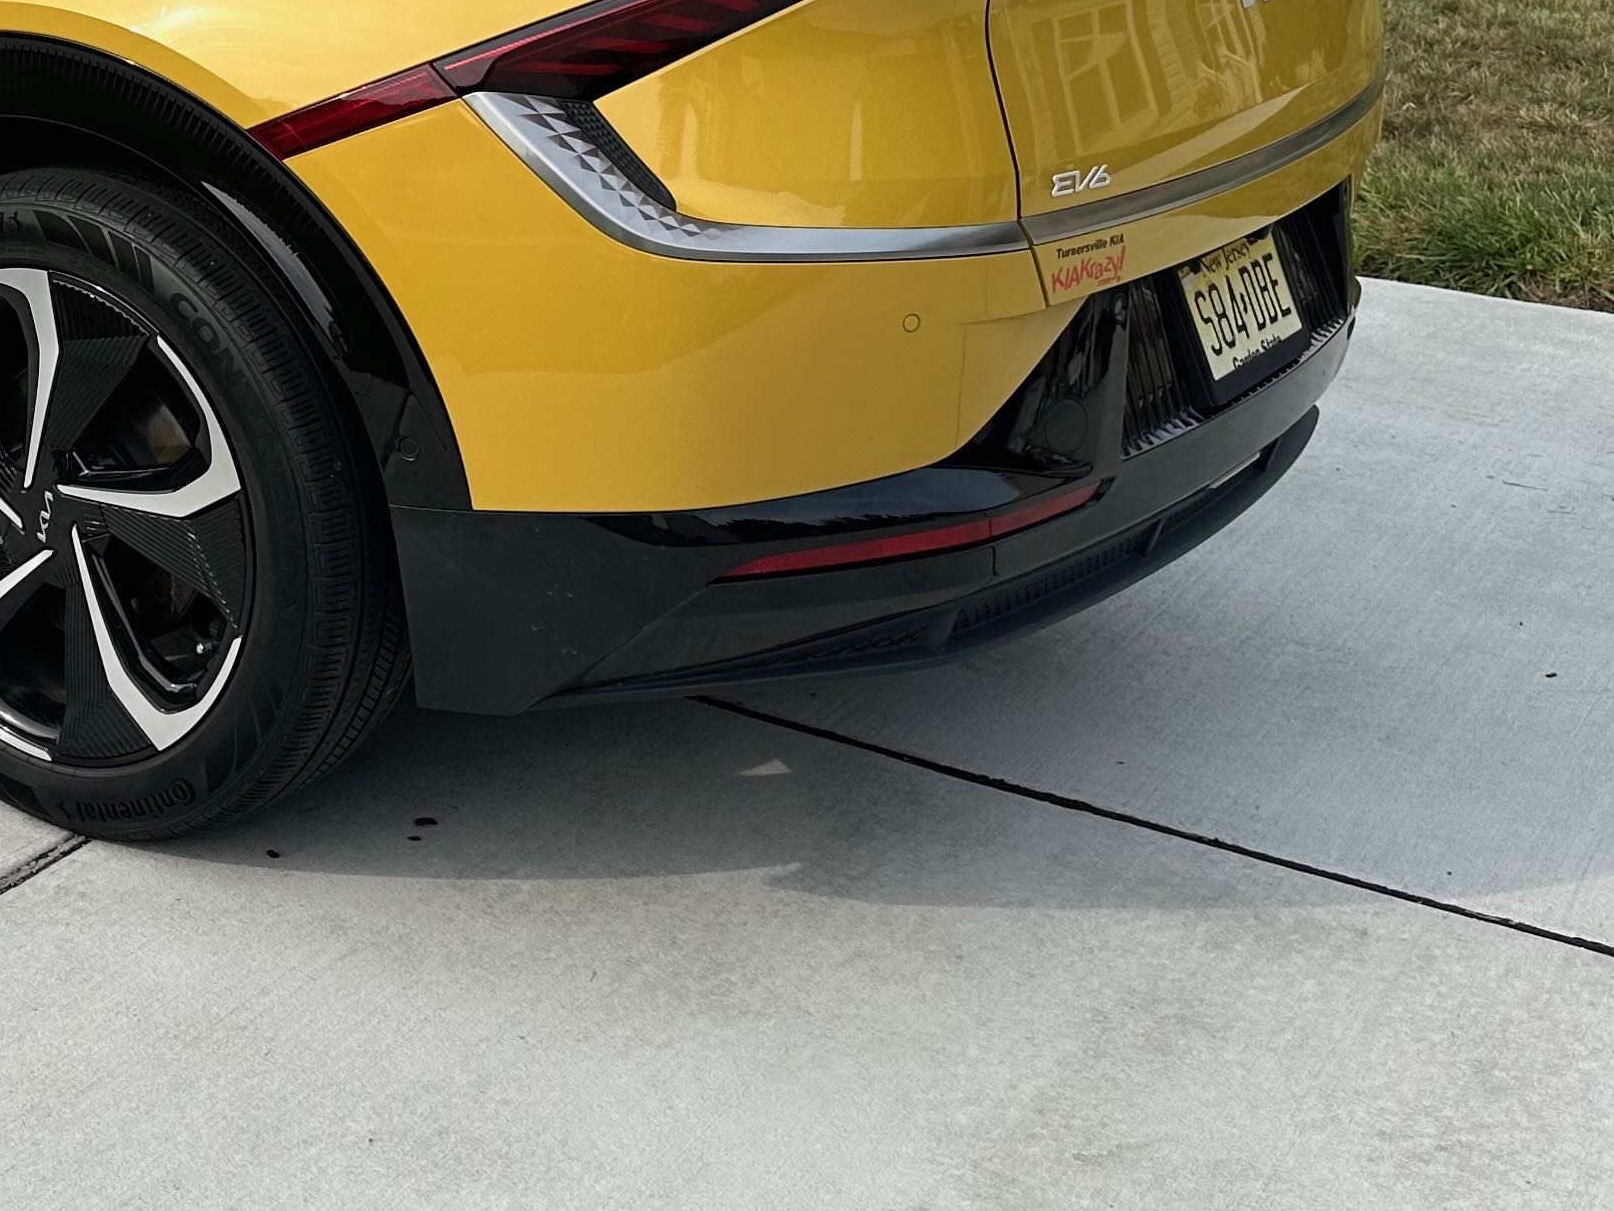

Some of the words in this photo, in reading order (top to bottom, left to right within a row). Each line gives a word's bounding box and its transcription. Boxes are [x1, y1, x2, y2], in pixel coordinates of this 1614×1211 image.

[1051, 164, 1112, 197] EV6
[1056, 238, 1108, 260] Turnersville
[1221, 241, 1251, 271] Jersey
[76, 776, 197, 823] Continental
